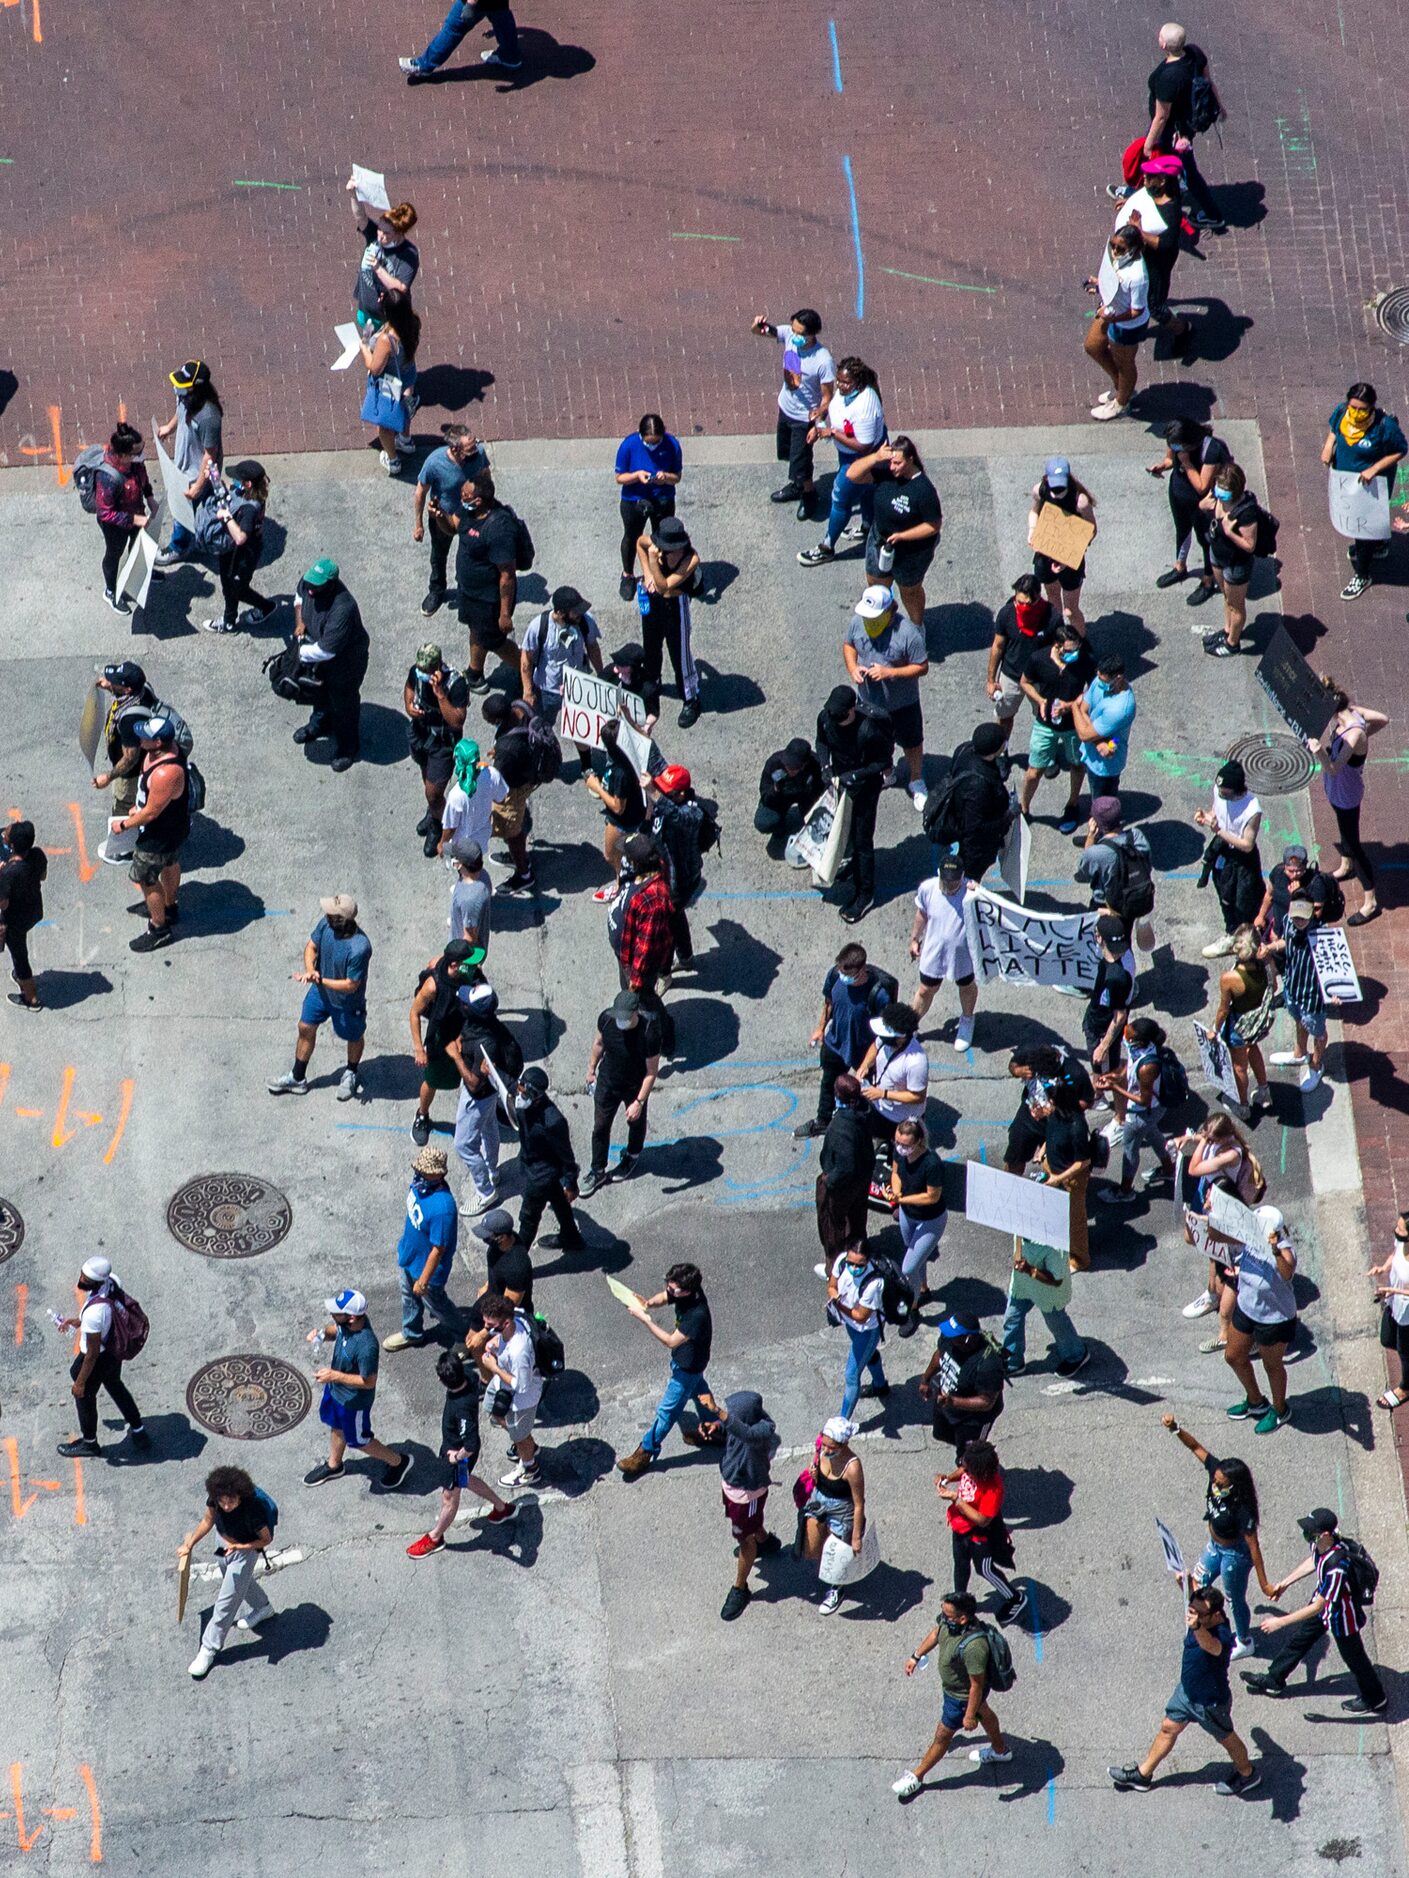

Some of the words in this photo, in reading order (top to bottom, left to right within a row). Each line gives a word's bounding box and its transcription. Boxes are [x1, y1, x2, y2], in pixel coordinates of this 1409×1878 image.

[563, 671, 583, 705] NO
[583, 678, 642, 724] JUSICE
[562, 705, 591, 739] NO
[975, 900, 1096, 941] BLACK
[979, 928, 1103, 964] LIVES
[982, 955, 1096, 981] MATTE
[1204, 1239, 1228, 1263] PLA
